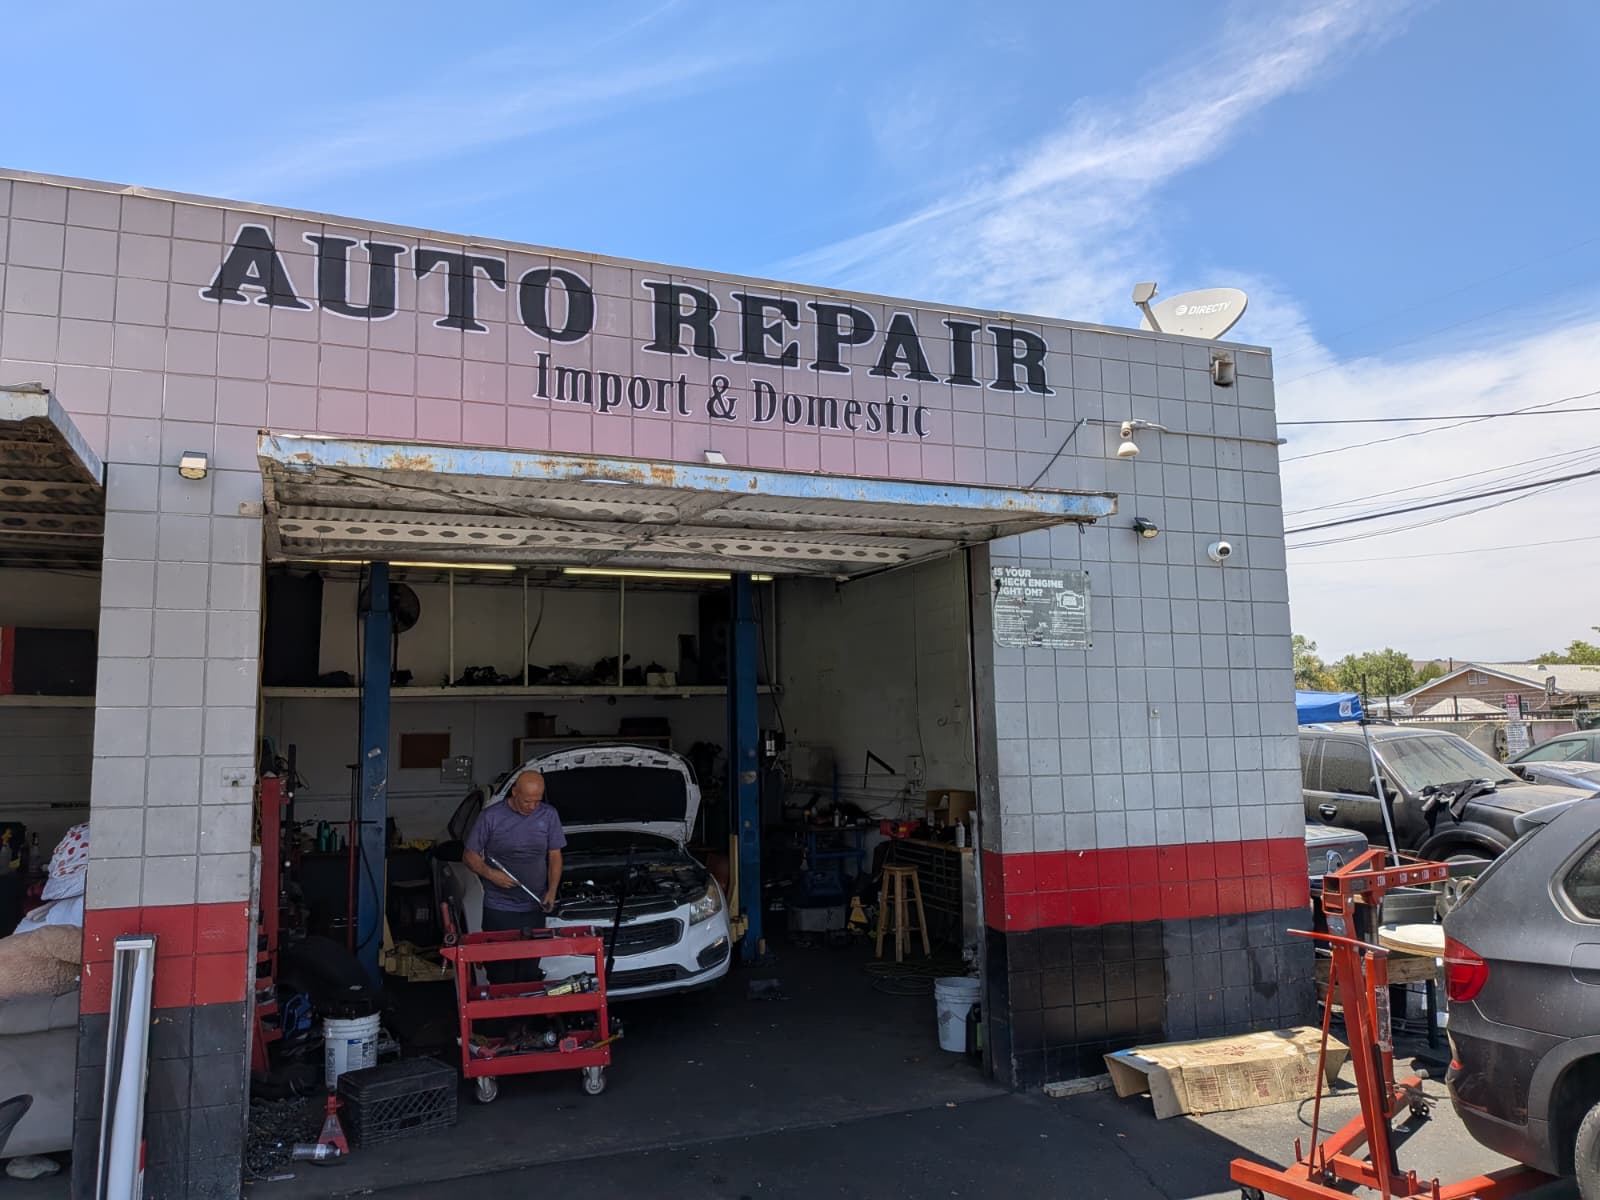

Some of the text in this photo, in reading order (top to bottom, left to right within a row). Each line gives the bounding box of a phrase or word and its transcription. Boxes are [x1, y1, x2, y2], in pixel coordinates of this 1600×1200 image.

[199, 223, 1057, 396] AUTO REPAIR
[1188, 302, 1232, 315] DIRECTV
[532, 351, 932, 438] Import & Domestic
[1005, 568, 1032, 578] YOUR
[1000, 577, 1064, 589] HECK ENGINE
[998, 587, 1043, 597] IGHT ON?
